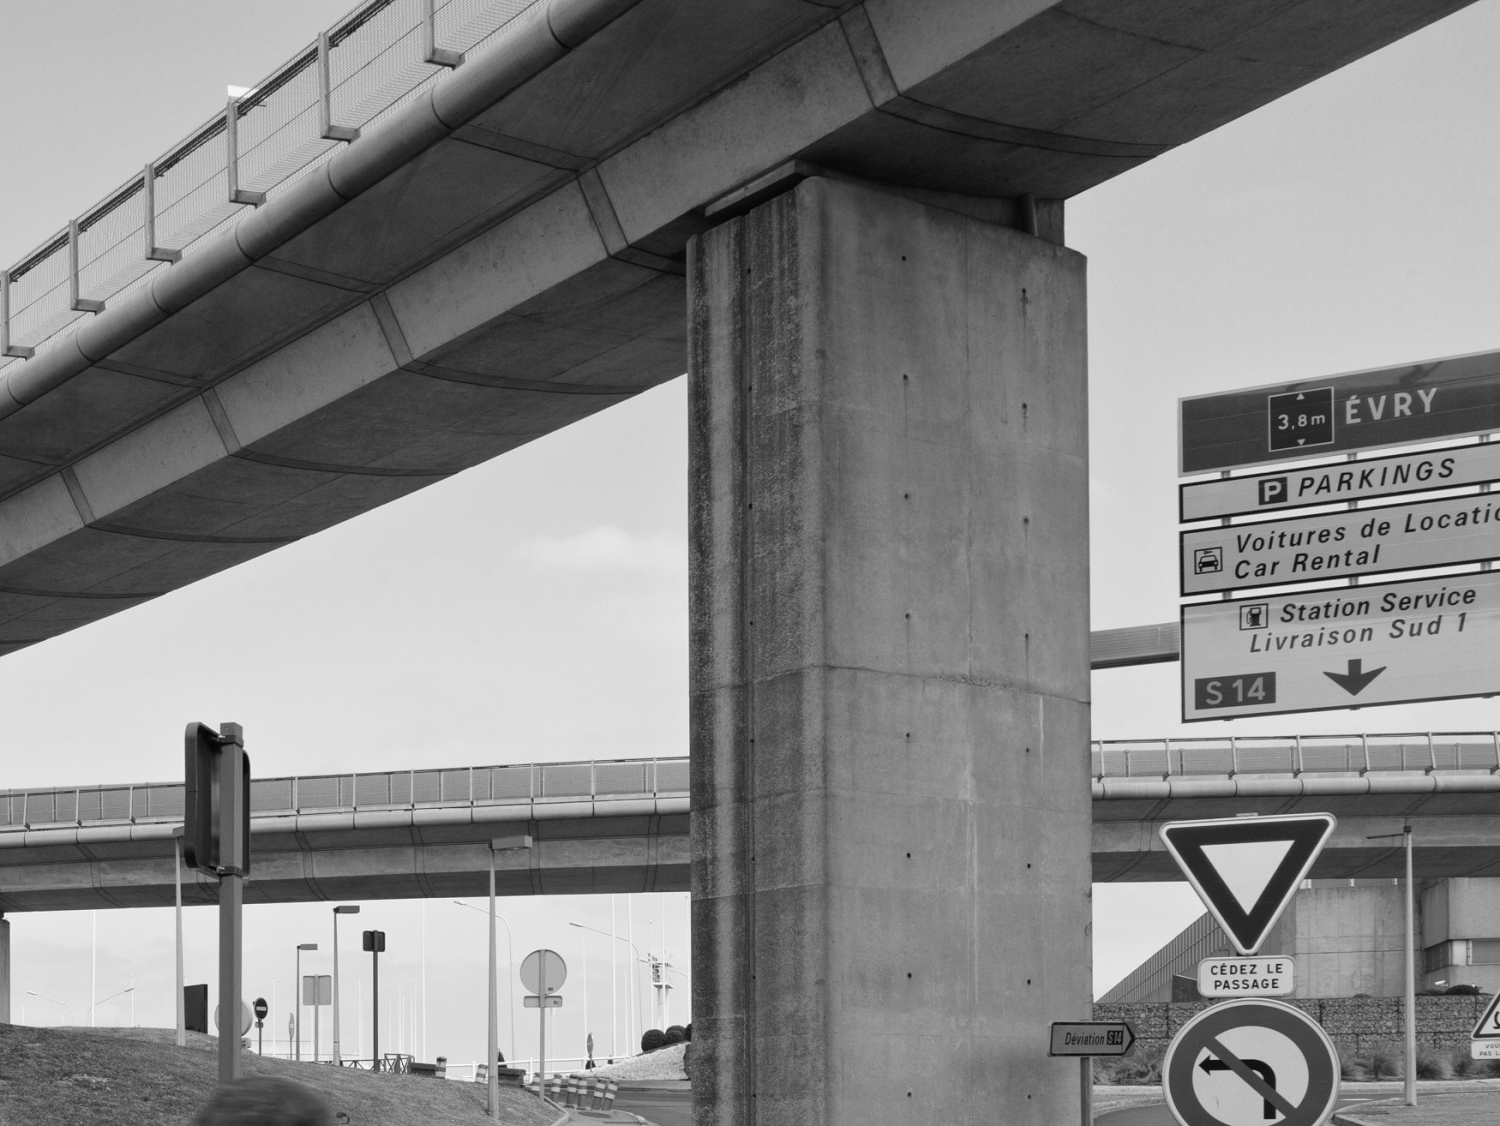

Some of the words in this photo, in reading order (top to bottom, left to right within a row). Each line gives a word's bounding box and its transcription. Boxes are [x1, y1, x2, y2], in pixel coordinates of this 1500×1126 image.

[1345, 387, 1438, 425] ÉVRY
[1297, 457, 1456, 498] PARKINGS
[1236, 525, 1347, 554] Voitures
[1360, 517, 1391, 539] de
[1234, 559, 1280, 580] Car
[1291, 544, 1381, 573] Rental
[1279, 598, 1371, 623] Station
[1379, 587, 1477, 613] Service
[1249, 627, 1374, 653] Livraison
[1388, 614, 1443, 640] Sud
[1456, 612, 1469, 633] 1
[1210, 963, 1258, 975] CÉDEZ
[1266, 963, 1284, 974] LE
[1214, 979, 1280, 990] PASSAGE
[1064, 1031, 1105, 1046] Déviation
[1107, 1031, 1123, 1045] S14
